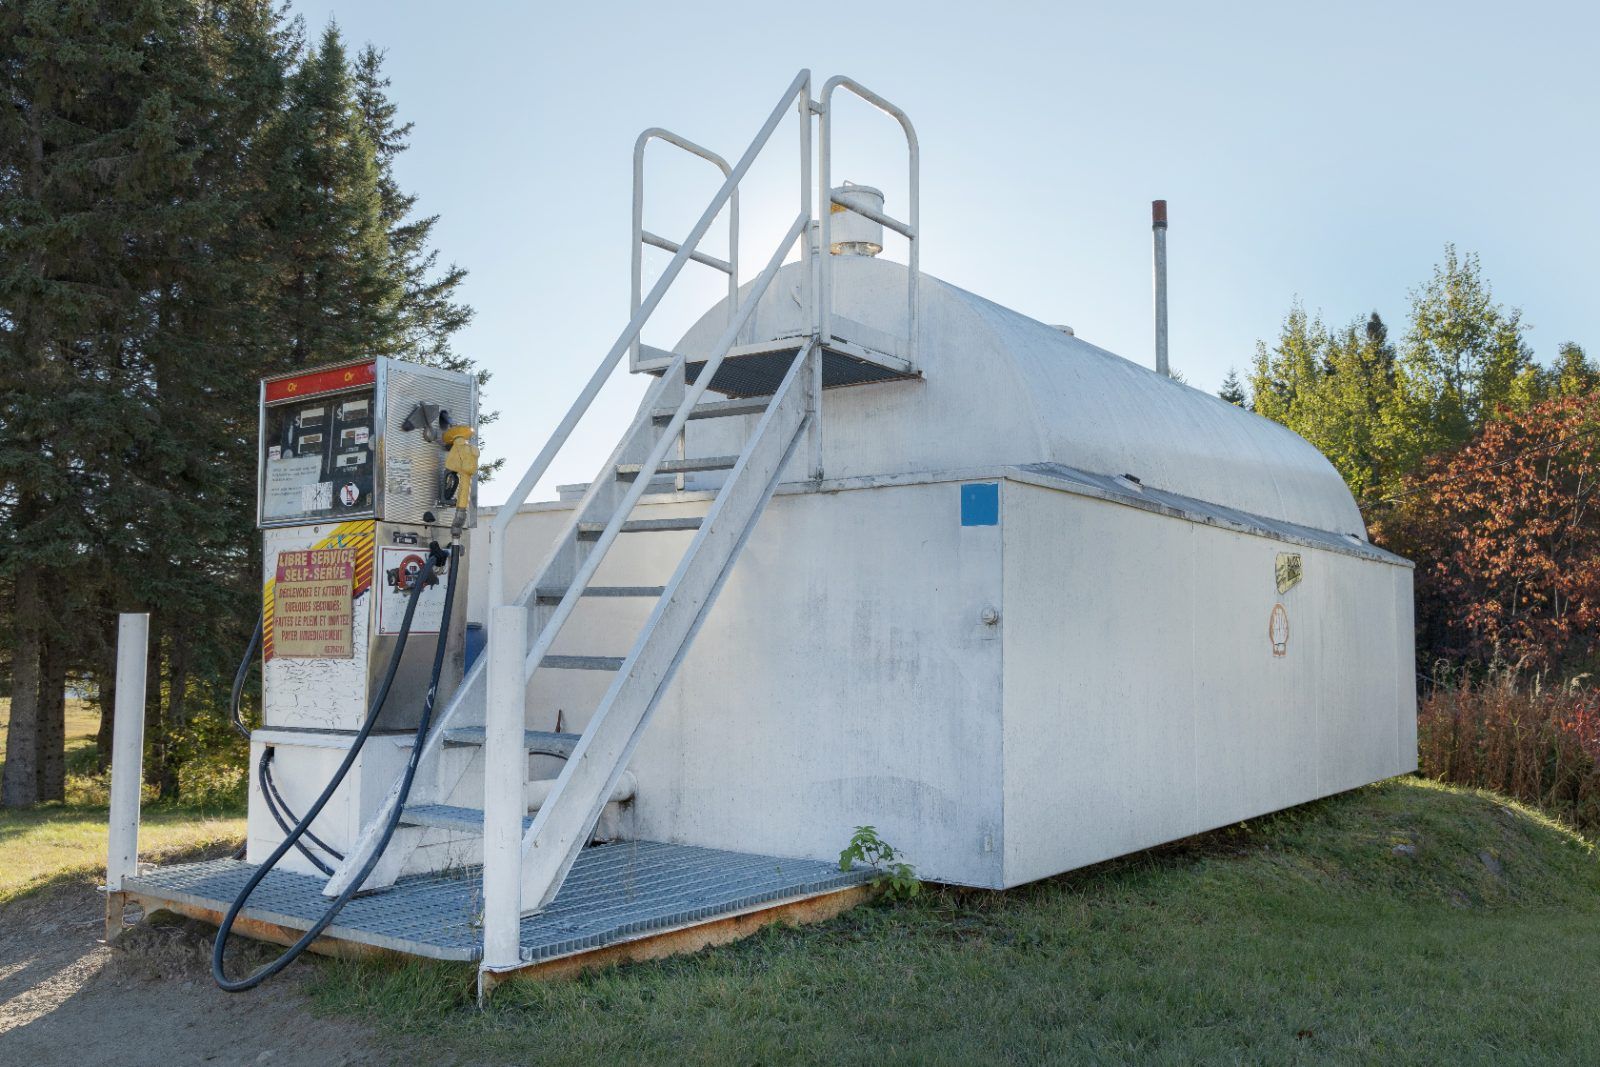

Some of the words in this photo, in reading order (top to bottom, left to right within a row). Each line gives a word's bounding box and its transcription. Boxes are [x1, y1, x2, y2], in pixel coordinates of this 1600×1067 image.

[279, 552, 308, 567] LIBRE
[311, 549, 355, 565] SERVICE
[314, 586, 320, 597] ET
[275, 616, 294, 627] FAITES
[295, 616, 300, 626] LE
[320, 615, 327, 626] ET
[281, 630, 298, 642] PAYER
